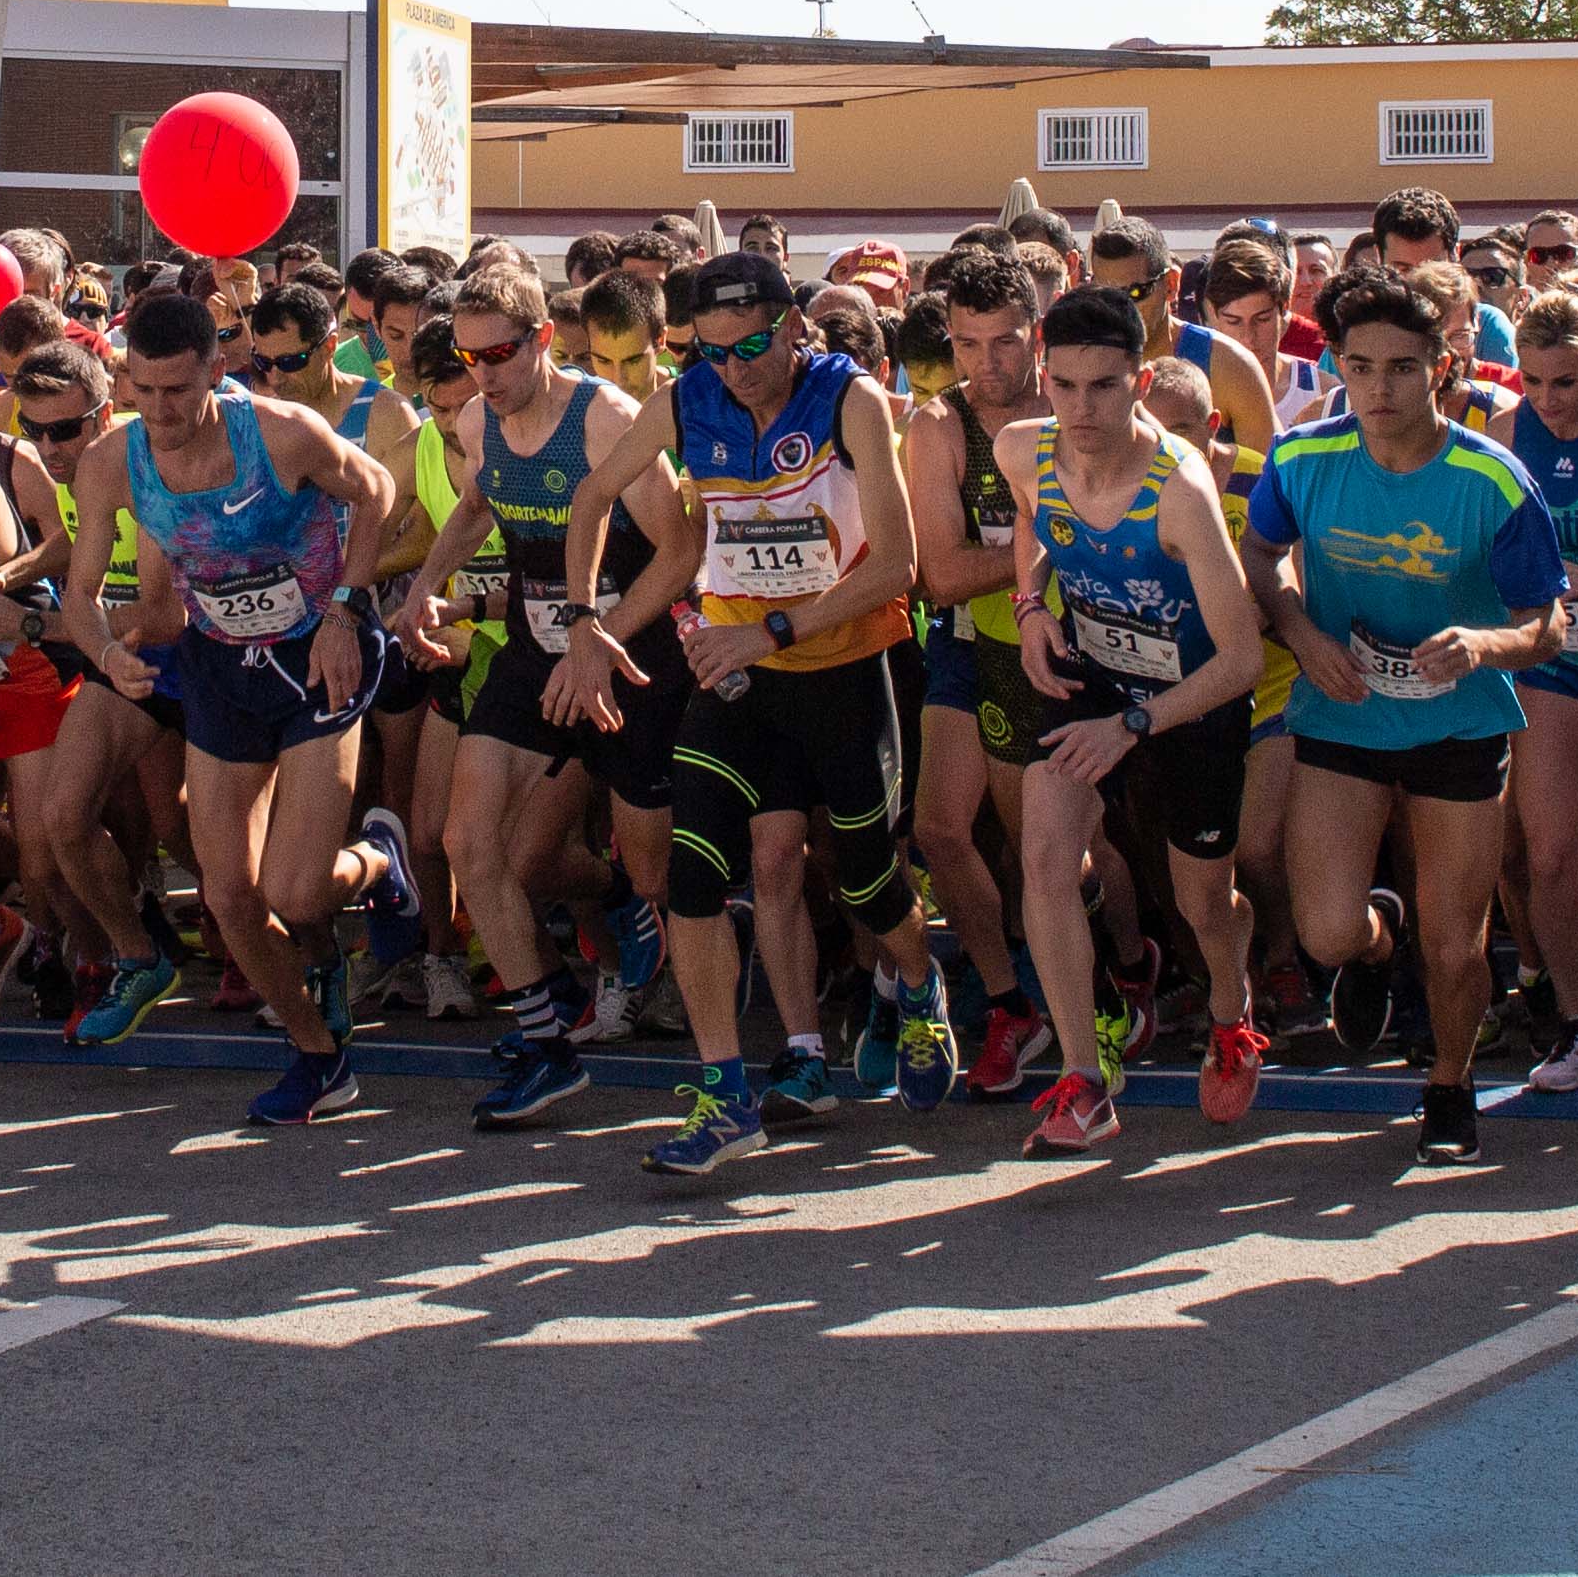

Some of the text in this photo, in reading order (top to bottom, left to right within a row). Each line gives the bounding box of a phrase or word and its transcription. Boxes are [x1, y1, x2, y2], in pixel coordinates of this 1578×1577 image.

[406, 1, 423, 22] PLAZA
[424, 7, 431, 25] DE
[745, 524, 808, 535] CARRERA POPULAR
[745, 545, 805, 571] 114
[217, 591, 275, 617] 236
[1105, 627, 1141, 654] 51
